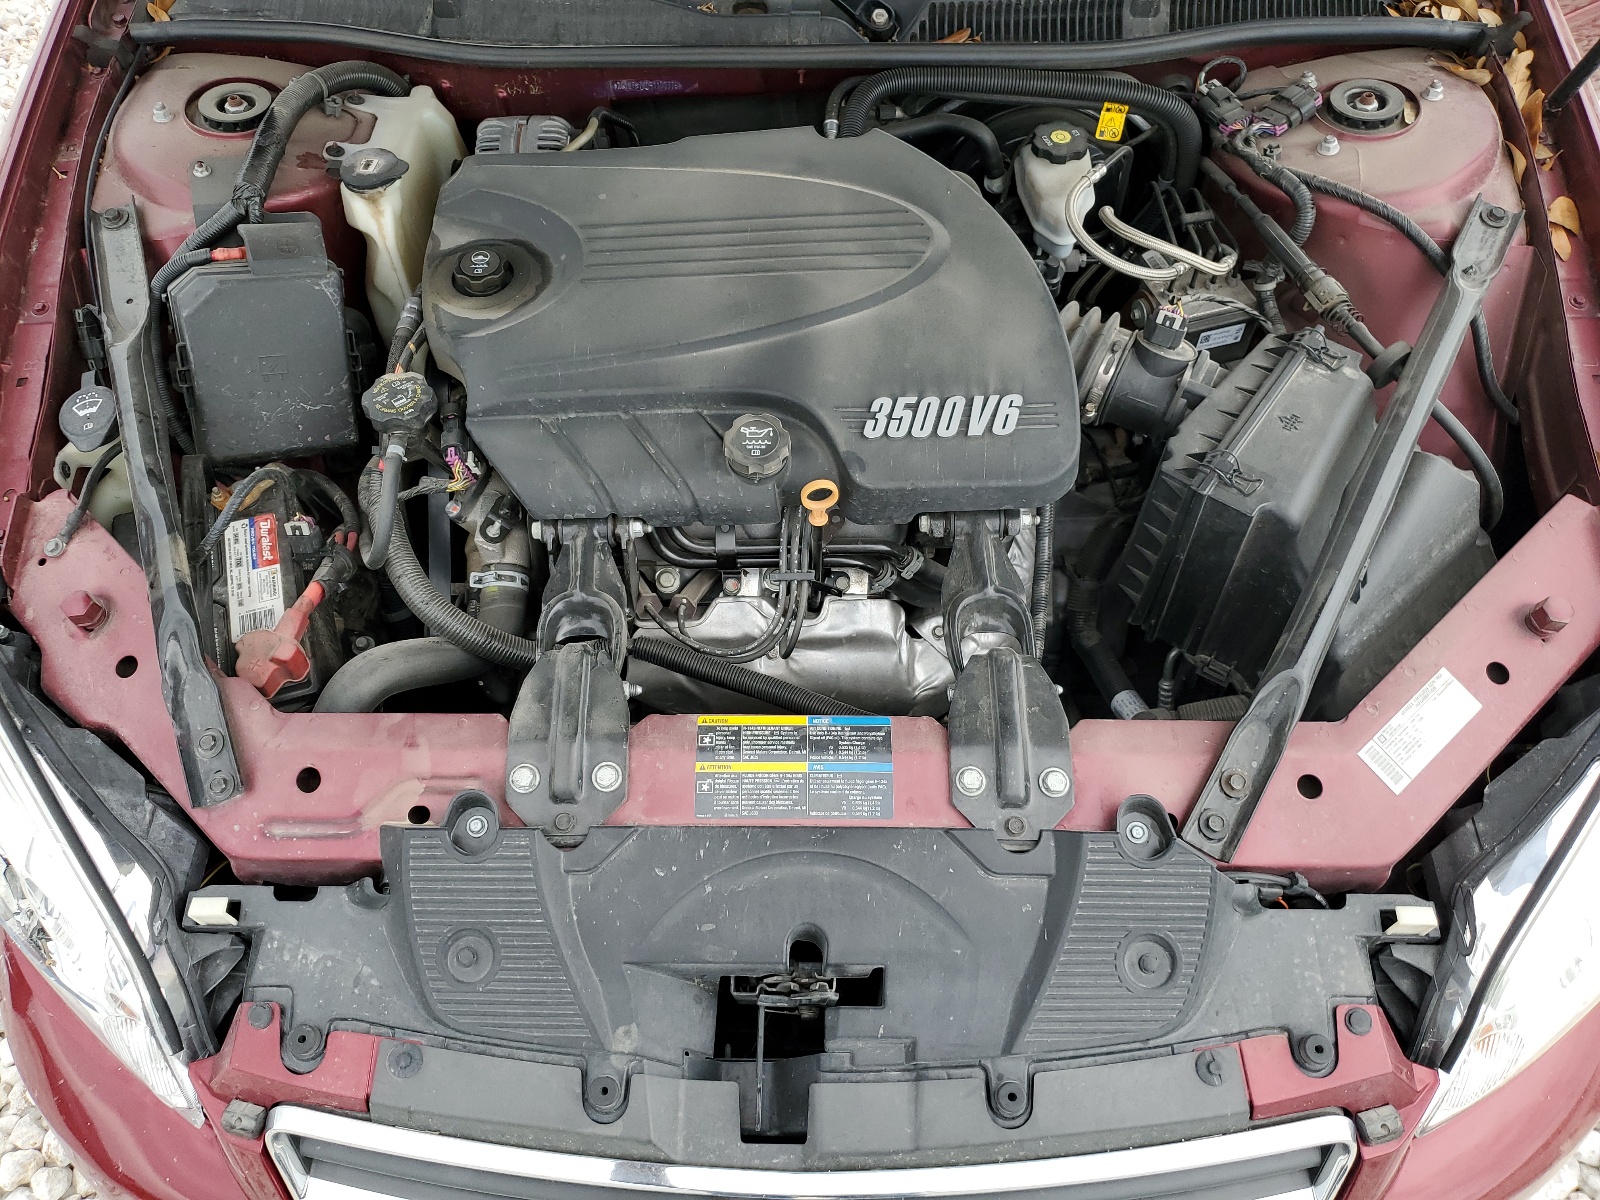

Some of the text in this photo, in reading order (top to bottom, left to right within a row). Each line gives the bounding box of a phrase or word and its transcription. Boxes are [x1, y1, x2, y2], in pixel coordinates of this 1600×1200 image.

[863, 394, 1024, 438] 3500 V6
[259, 519, 273, 561] Duralast
